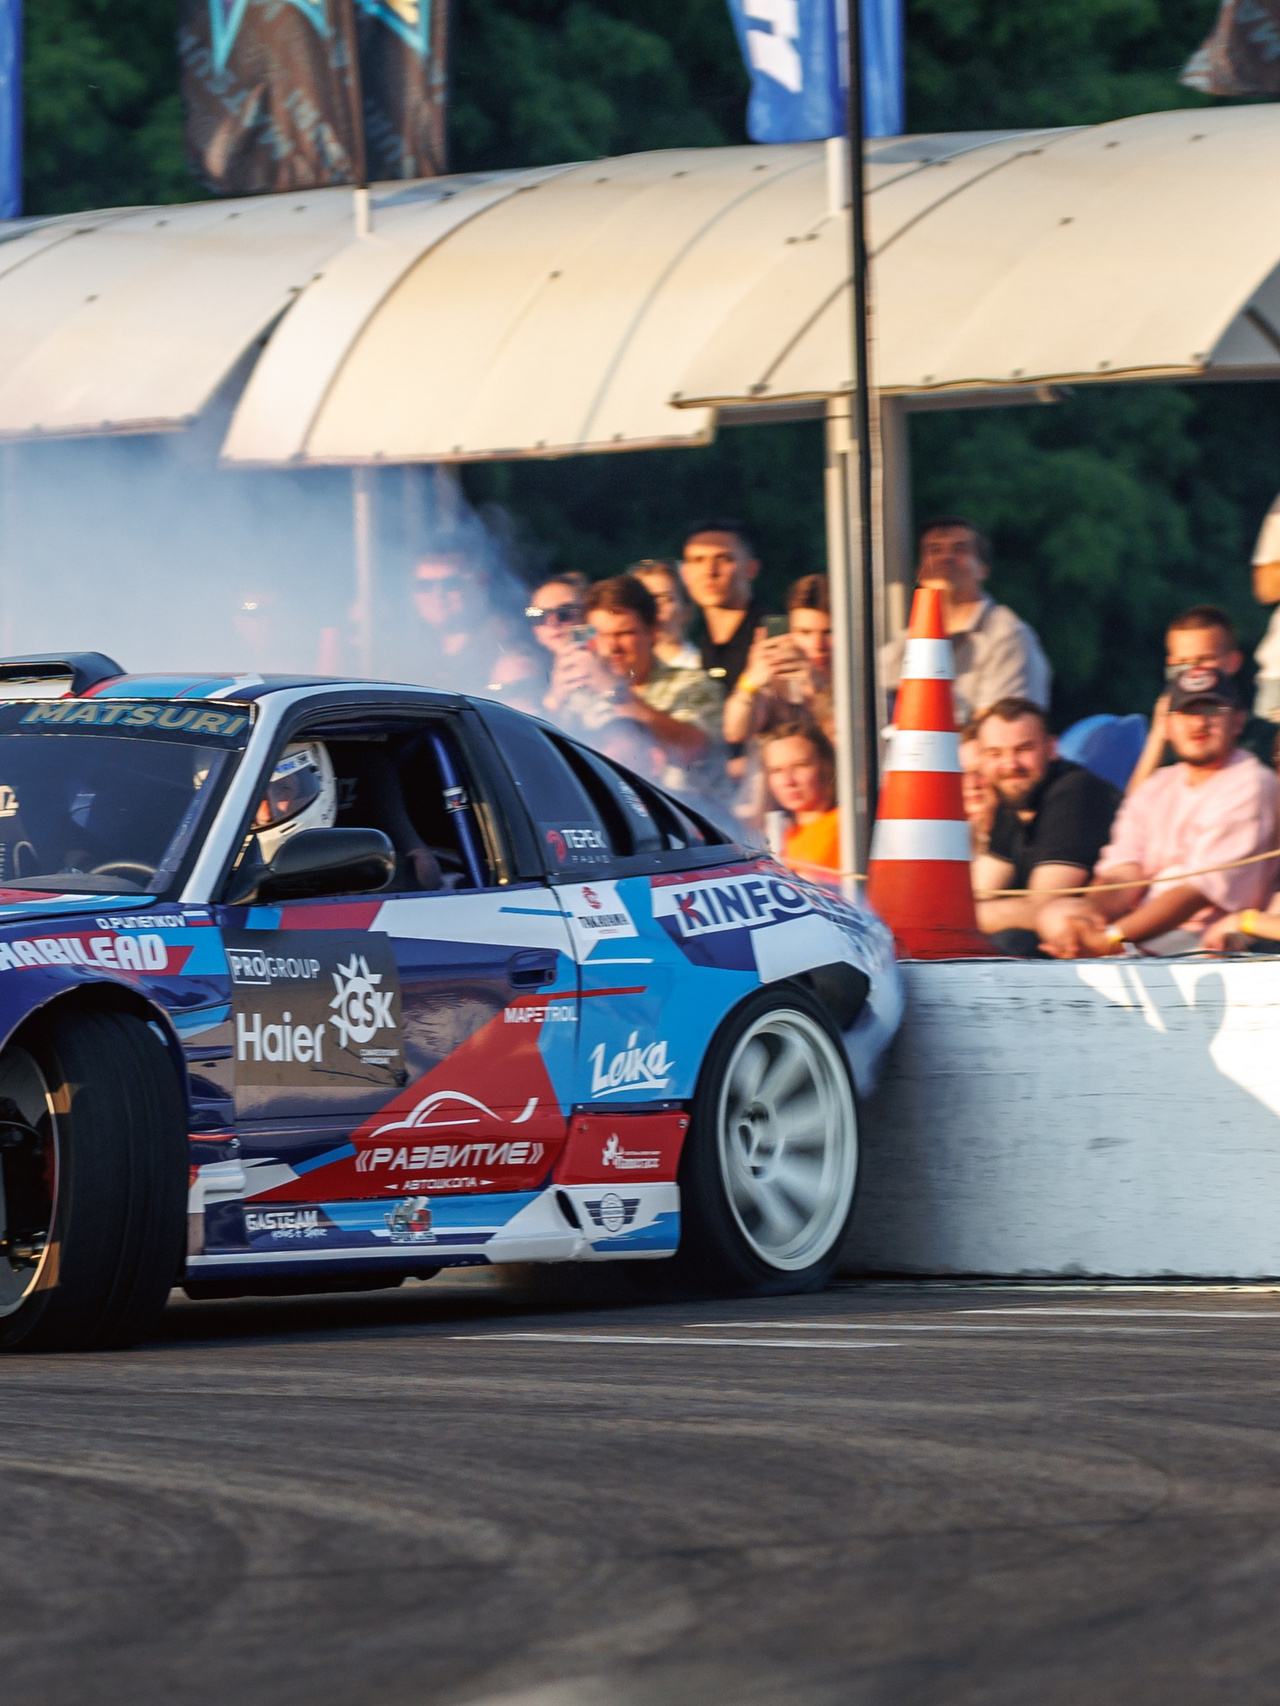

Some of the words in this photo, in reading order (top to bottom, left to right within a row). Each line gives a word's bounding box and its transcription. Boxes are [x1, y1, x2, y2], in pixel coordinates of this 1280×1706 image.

[21, 702, 250, 736] MATSURI
[504, 1006, 579, 1024] MAPETROL
[236, 1011, 326, 1062] Haier
